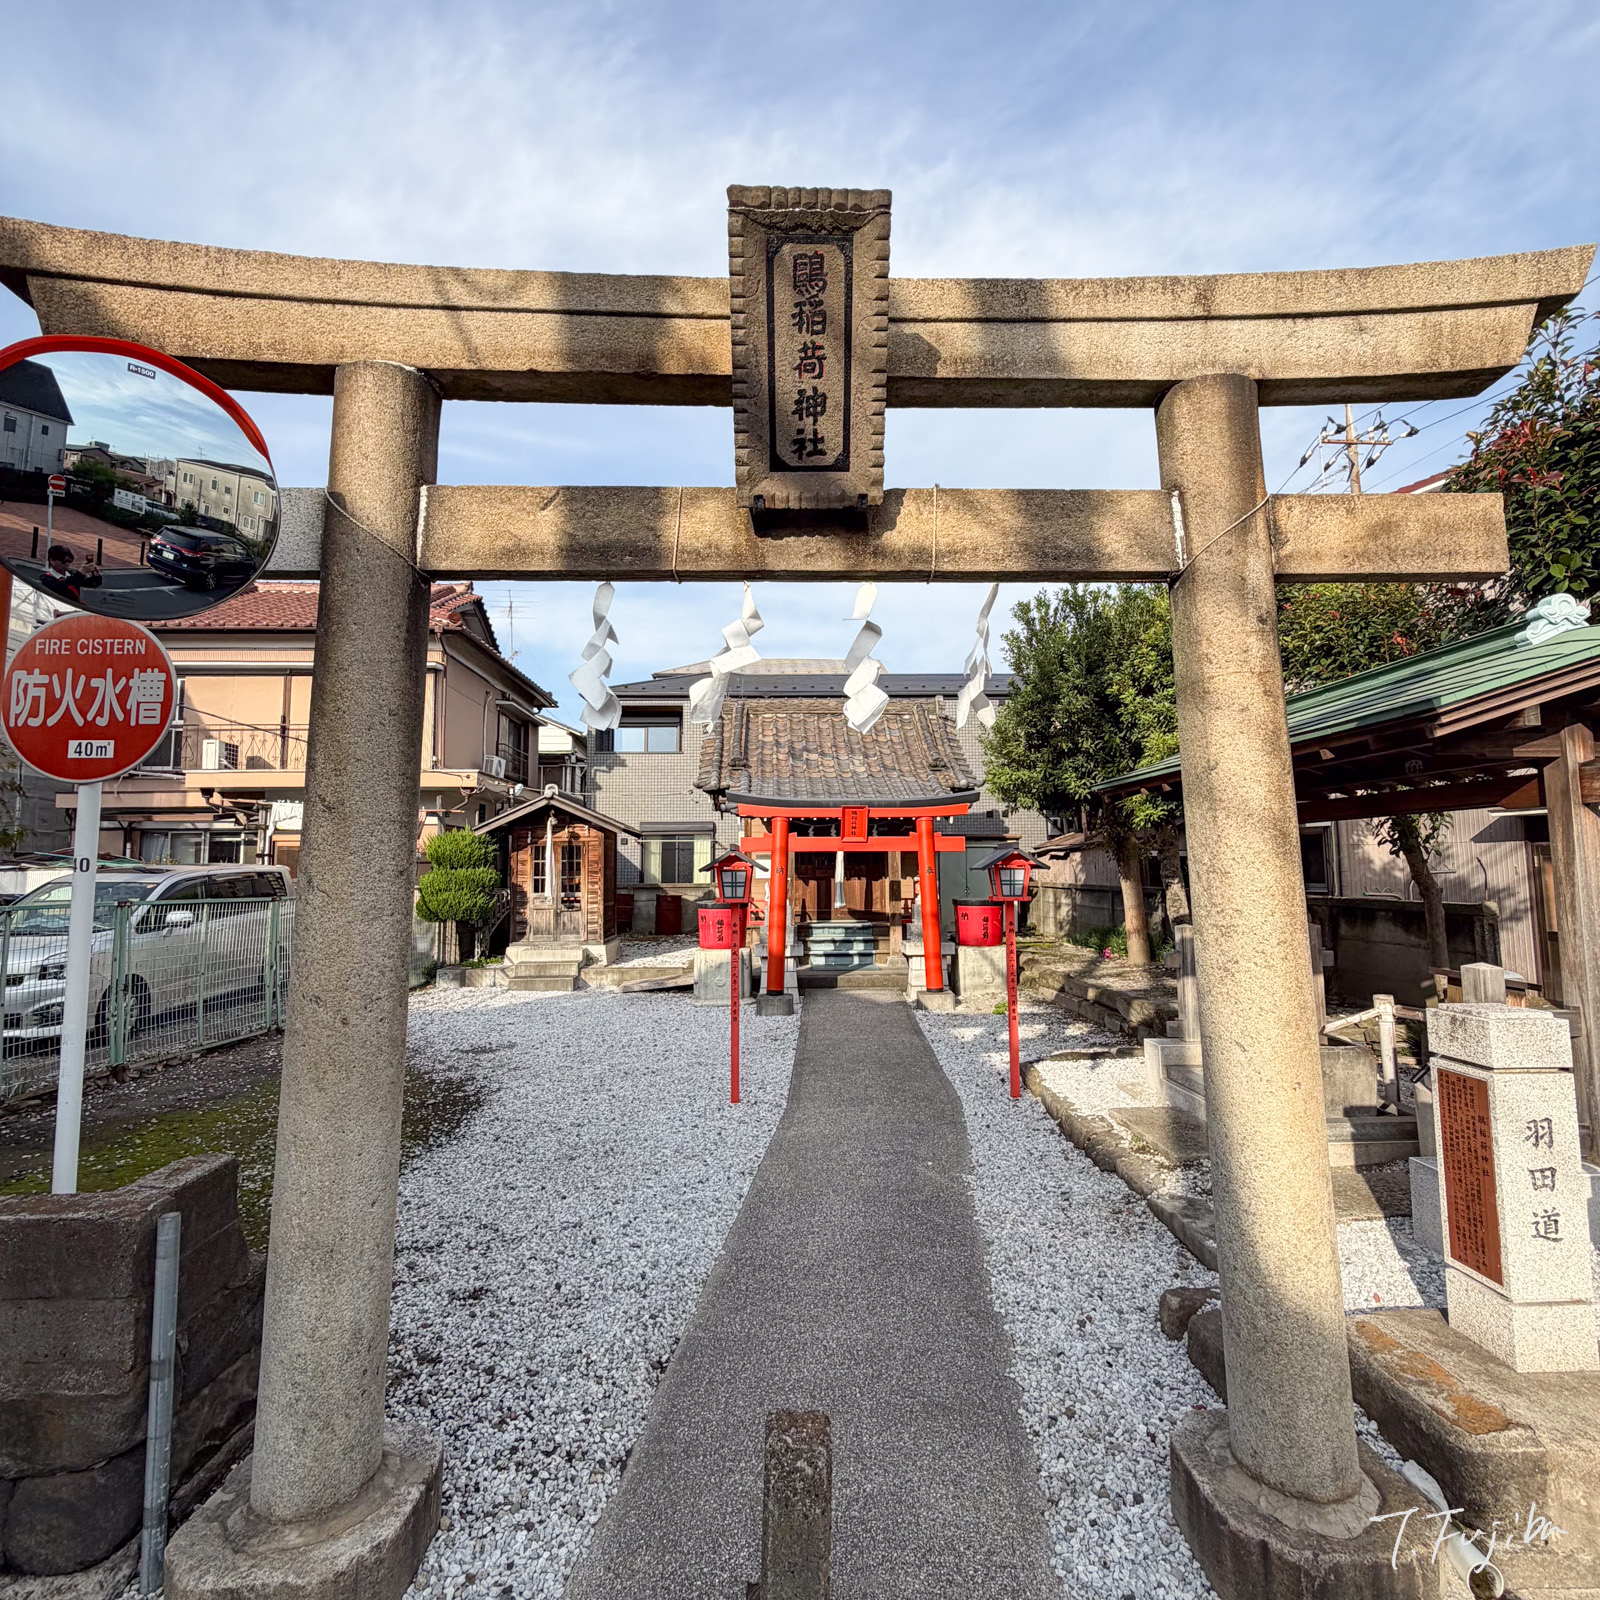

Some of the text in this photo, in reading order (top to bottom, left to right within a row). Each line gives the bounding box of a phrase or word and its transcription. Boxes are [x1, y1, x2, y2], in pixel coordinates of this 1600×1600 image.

[35, 638, 147, 655] FIRE CISTERN
[8, 667, 167, 728] 防火水槽
[1523, 1117, 1564, 1243] 羽田道
